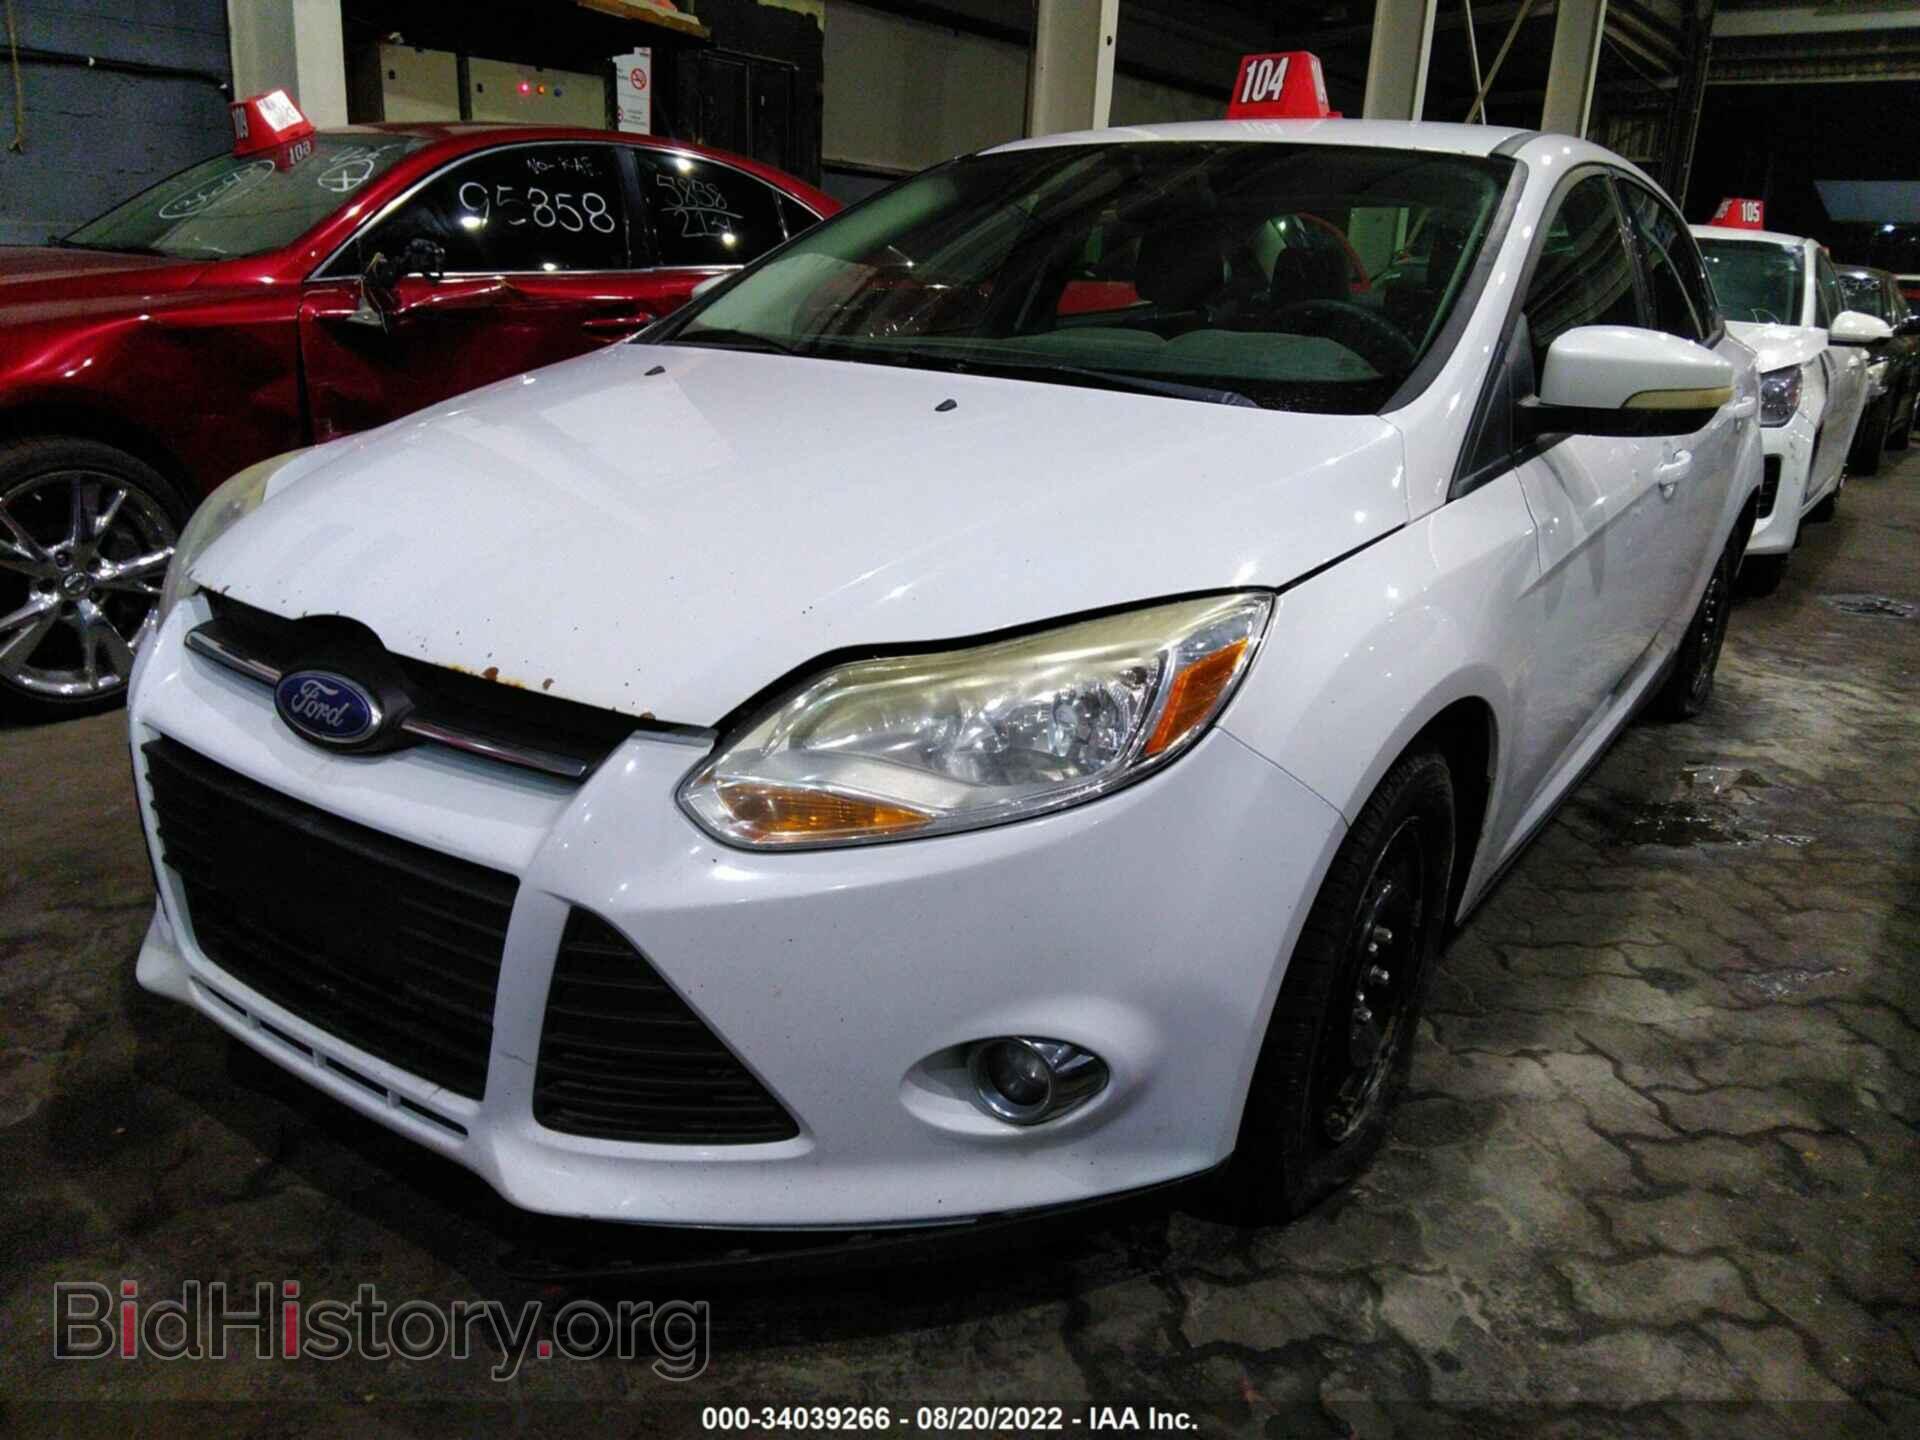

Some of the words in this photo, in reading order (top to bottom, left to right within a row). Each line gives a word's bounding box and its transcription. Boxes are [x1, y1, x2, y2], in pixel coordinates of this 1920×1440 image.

[1240, 56, 1289, 103] 104
[458, 181, 616, 233] 95858
[1741, 200, 1761, 223] 105
[291, 679, 350, 727] Ford
